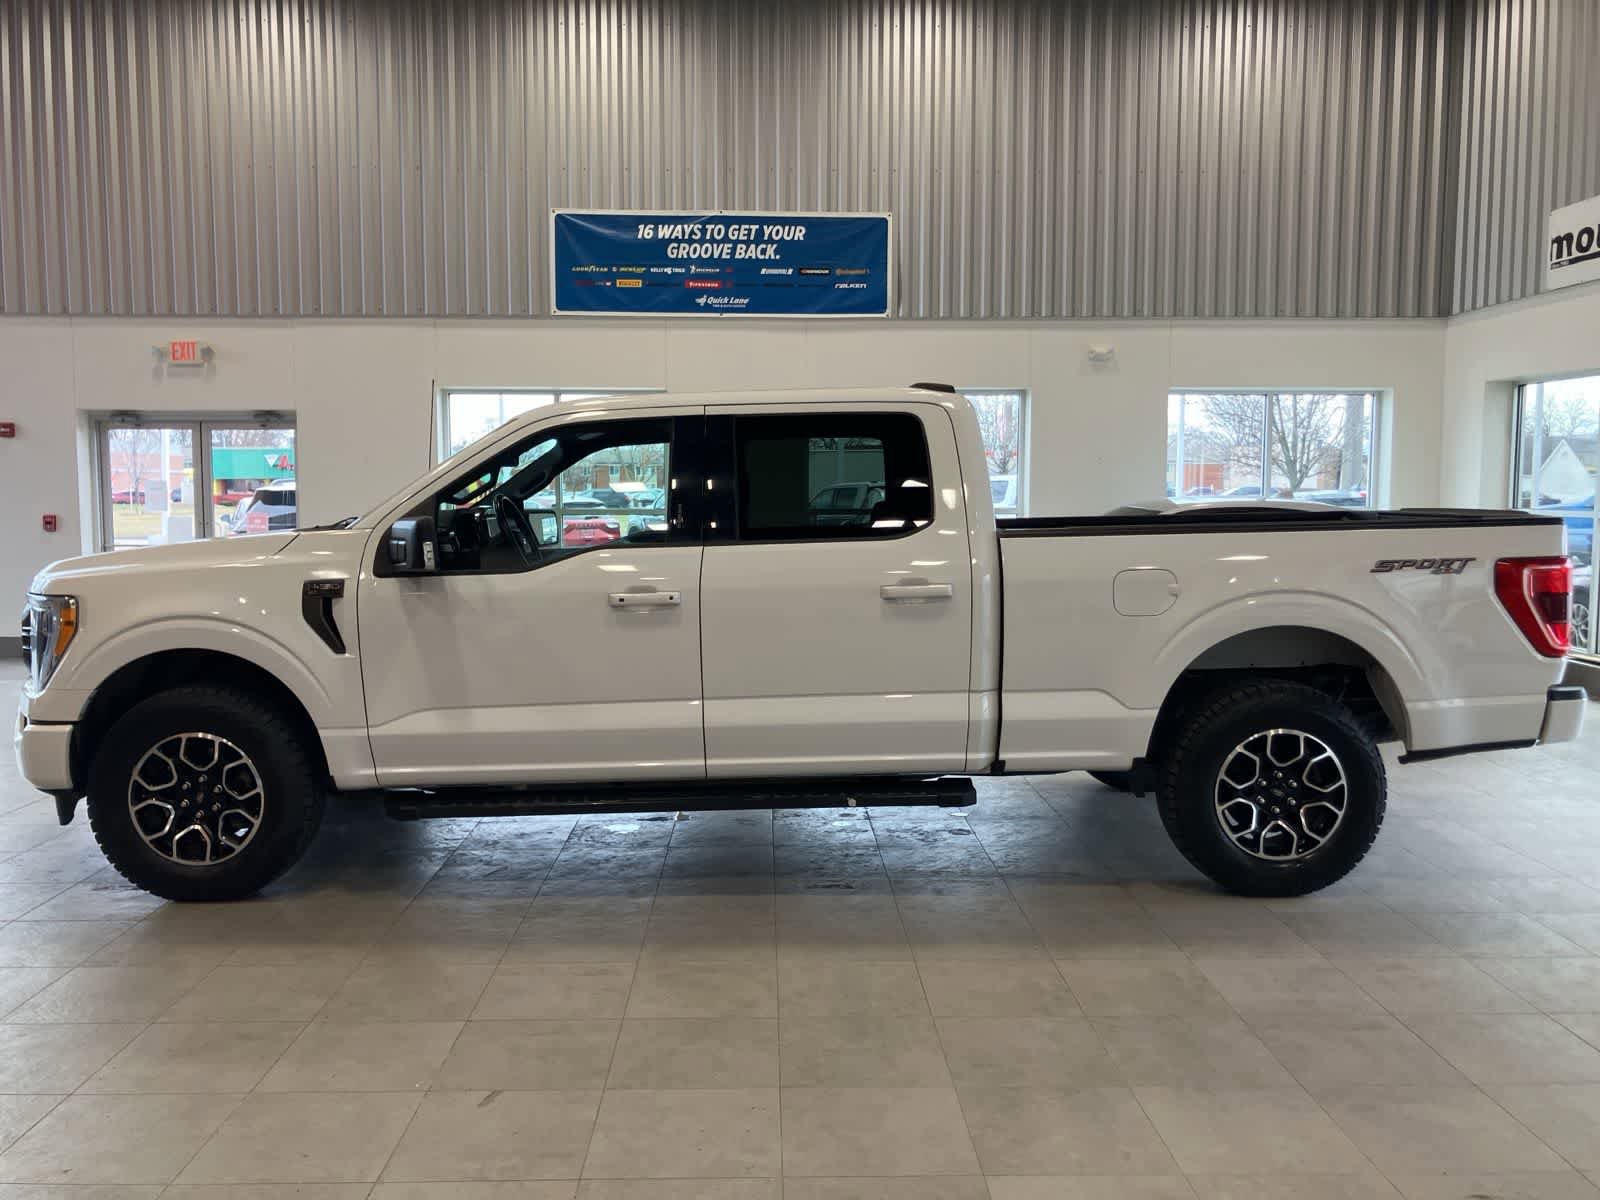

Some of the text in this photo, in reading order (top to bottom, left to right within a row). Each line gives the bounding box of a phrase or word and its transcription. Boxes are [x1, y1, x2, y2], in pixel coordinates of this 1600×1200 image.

[637, 224, 806, 241] 16 WAYS TO GET YOUR
[1550, 223, 1600, 262] mo
[667, 243, 781, 260] GROOVE BACK.
[707, 296, 750, 304] Quick Lane
[171, 341, 197, 361] EXIT
[1369, 557, 1477, 573] SPORT
